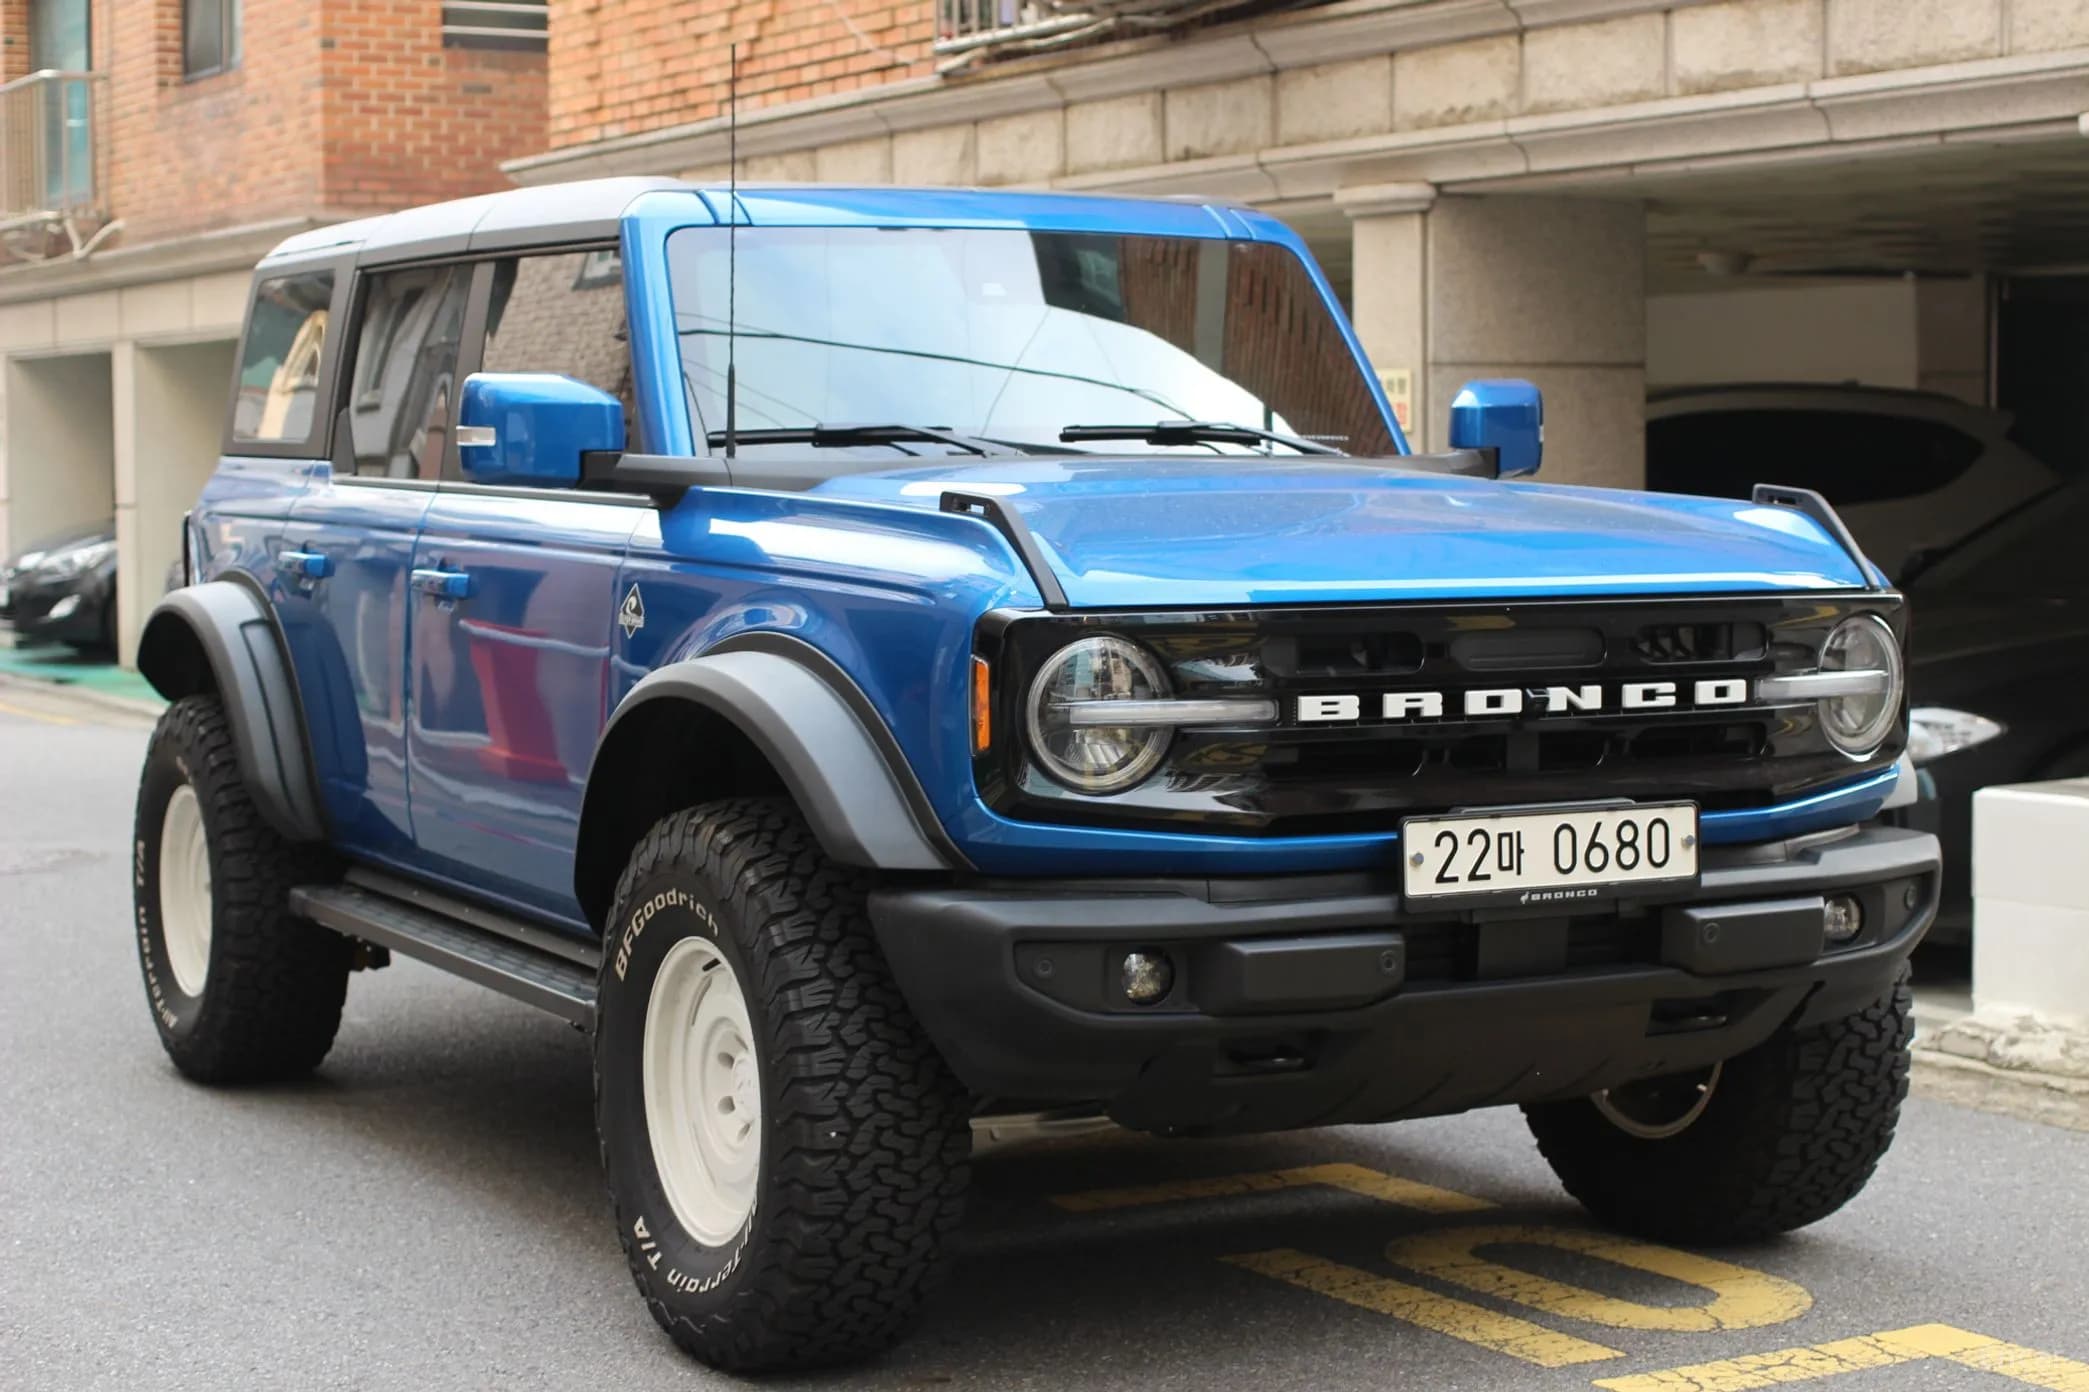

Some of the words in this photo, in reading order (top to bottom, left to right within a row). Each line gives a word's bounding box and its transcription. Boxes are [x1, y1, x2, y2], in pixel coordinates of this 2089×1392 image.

[1297, 679, 1747, 721] BRONCO
[1434, 829, 1525, 884] 22마
[1553, 817, 1670, 875] 0680
[1531, 888, 1598, 901] BRONCO
[615, 887, 718, 982] BFGoodrich
[633, 1215, 662, 1271] T/A
